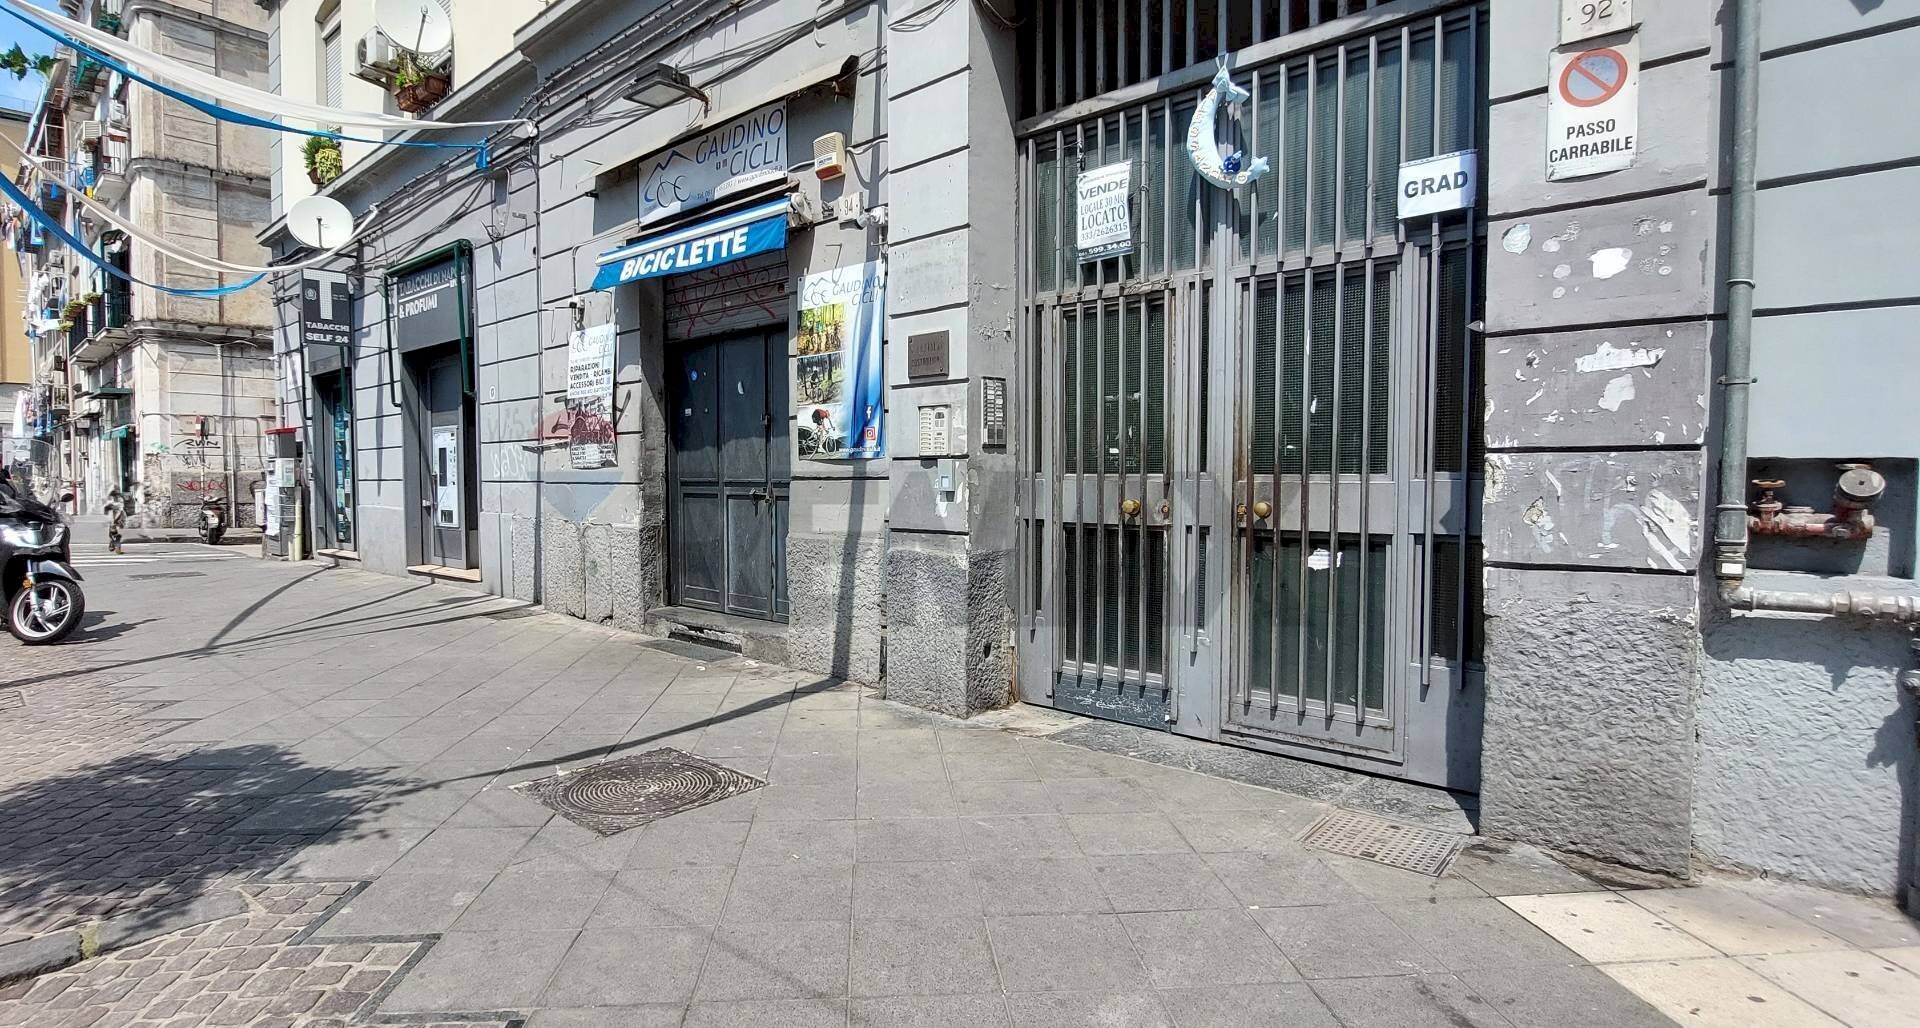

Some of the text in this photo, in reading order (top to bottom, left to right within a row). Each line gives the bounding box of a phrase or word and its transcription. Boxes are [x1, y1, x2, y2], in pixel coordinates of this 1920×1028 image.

[1581, 0, 1613, 25] 92
[696, 108, 784, 164] GAUDINO
[1567, 118, 1616, 140] PASSO
[729, 137, 781, 177] CICLI
[1549, 136, 1633, 163] CARRABILE
[1079, 178, 1128, 201] VENDE
[1404, 170, 1469, 199] GRAD
[844, 198, 854, 216] 94
[1080, 198, 1104, 216] LOCALE
[1104, 195, 1113, 208] 30
[1081, 204, 1126, 231] LOCATO
[619, 226, 749, 282] BICICLETTE
[832, 275, 882, 296] GAUDINO
[399, 293, 438, 319] & PROFUMI
[852, 289, 880, 306] CICLI
[305, 321, 350, 333] TABACCHI
[305, 332, 349, 344] SELF 24
[569, 372, 589, 382] VENDITA
[570, 377, 605, 389] ACCESSORI BICI
